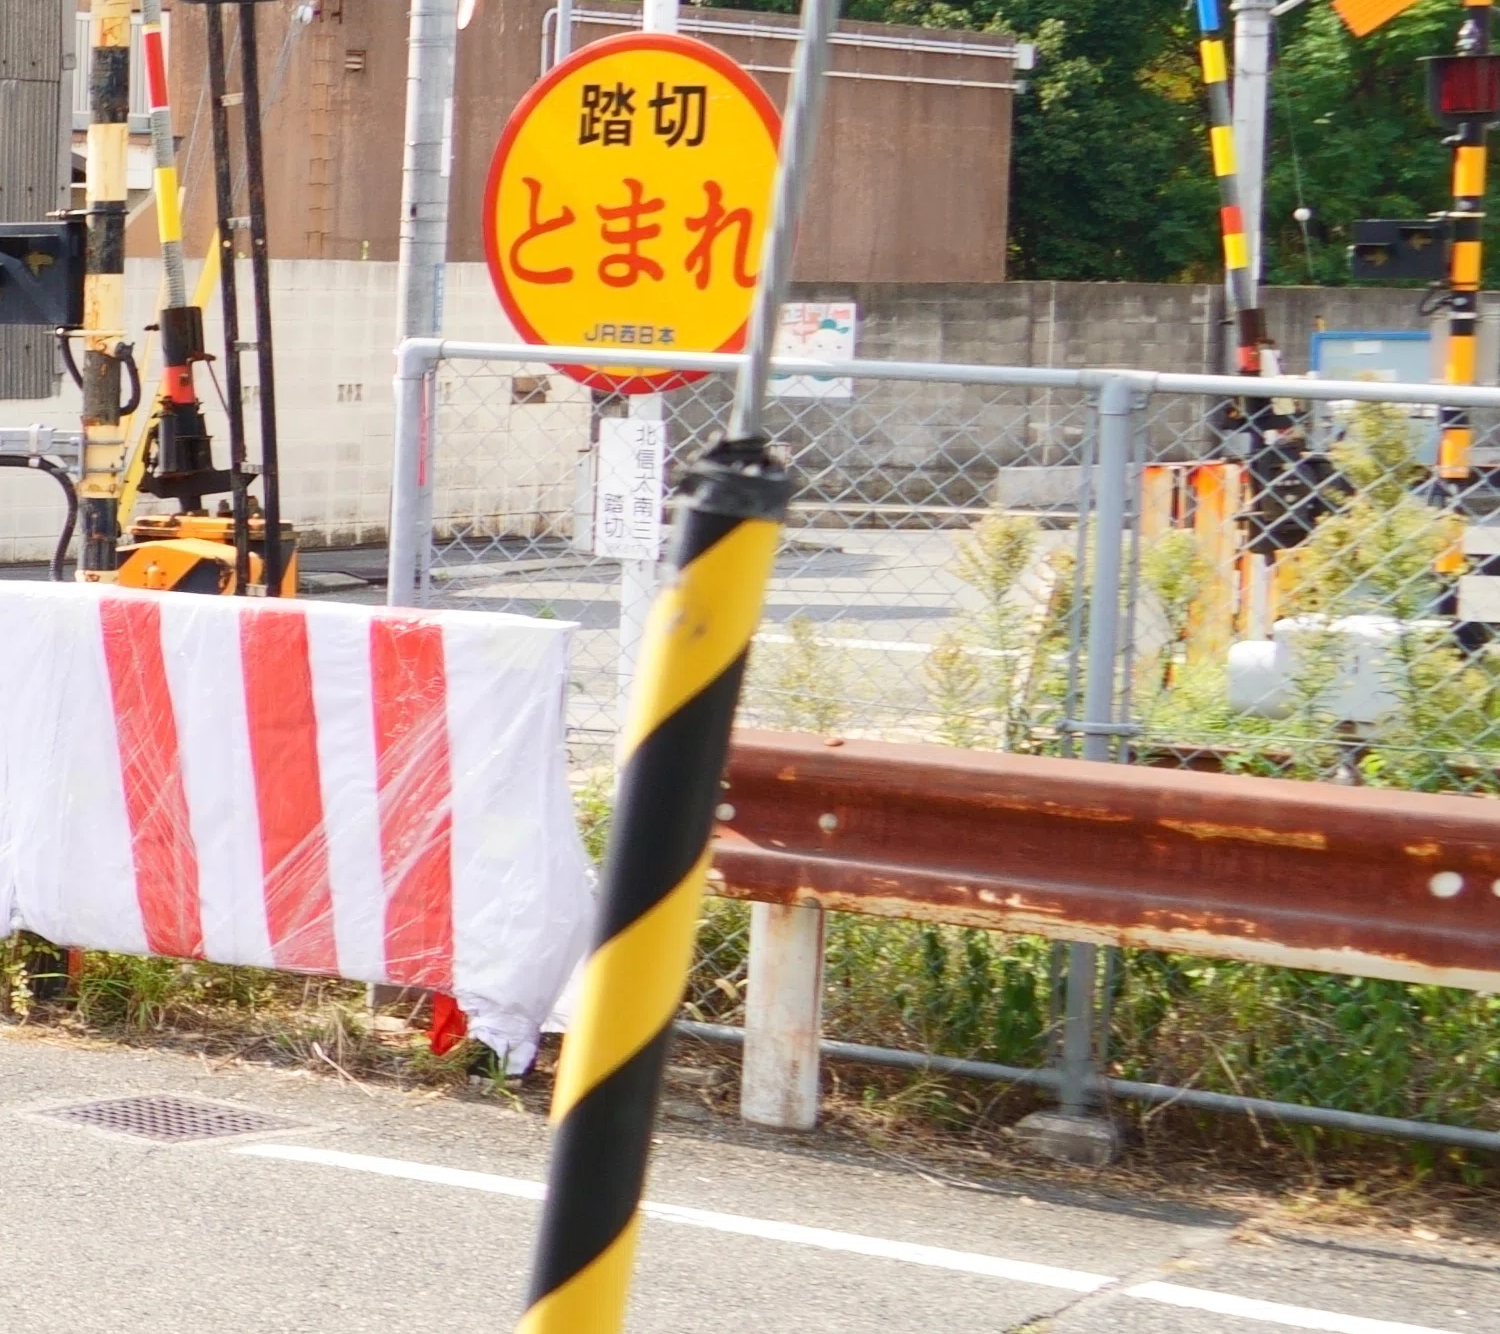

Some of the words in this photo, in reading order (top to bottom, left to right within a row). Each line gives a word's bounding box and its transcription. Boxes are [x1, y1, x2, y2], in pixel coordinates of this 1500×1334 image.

[579, 81, 708, 147] 踏切
[508, 177, 762, 291] とまれ
[583, 323, 675, 346] JR西日本
[603, 493, 625, 539] 踏切
